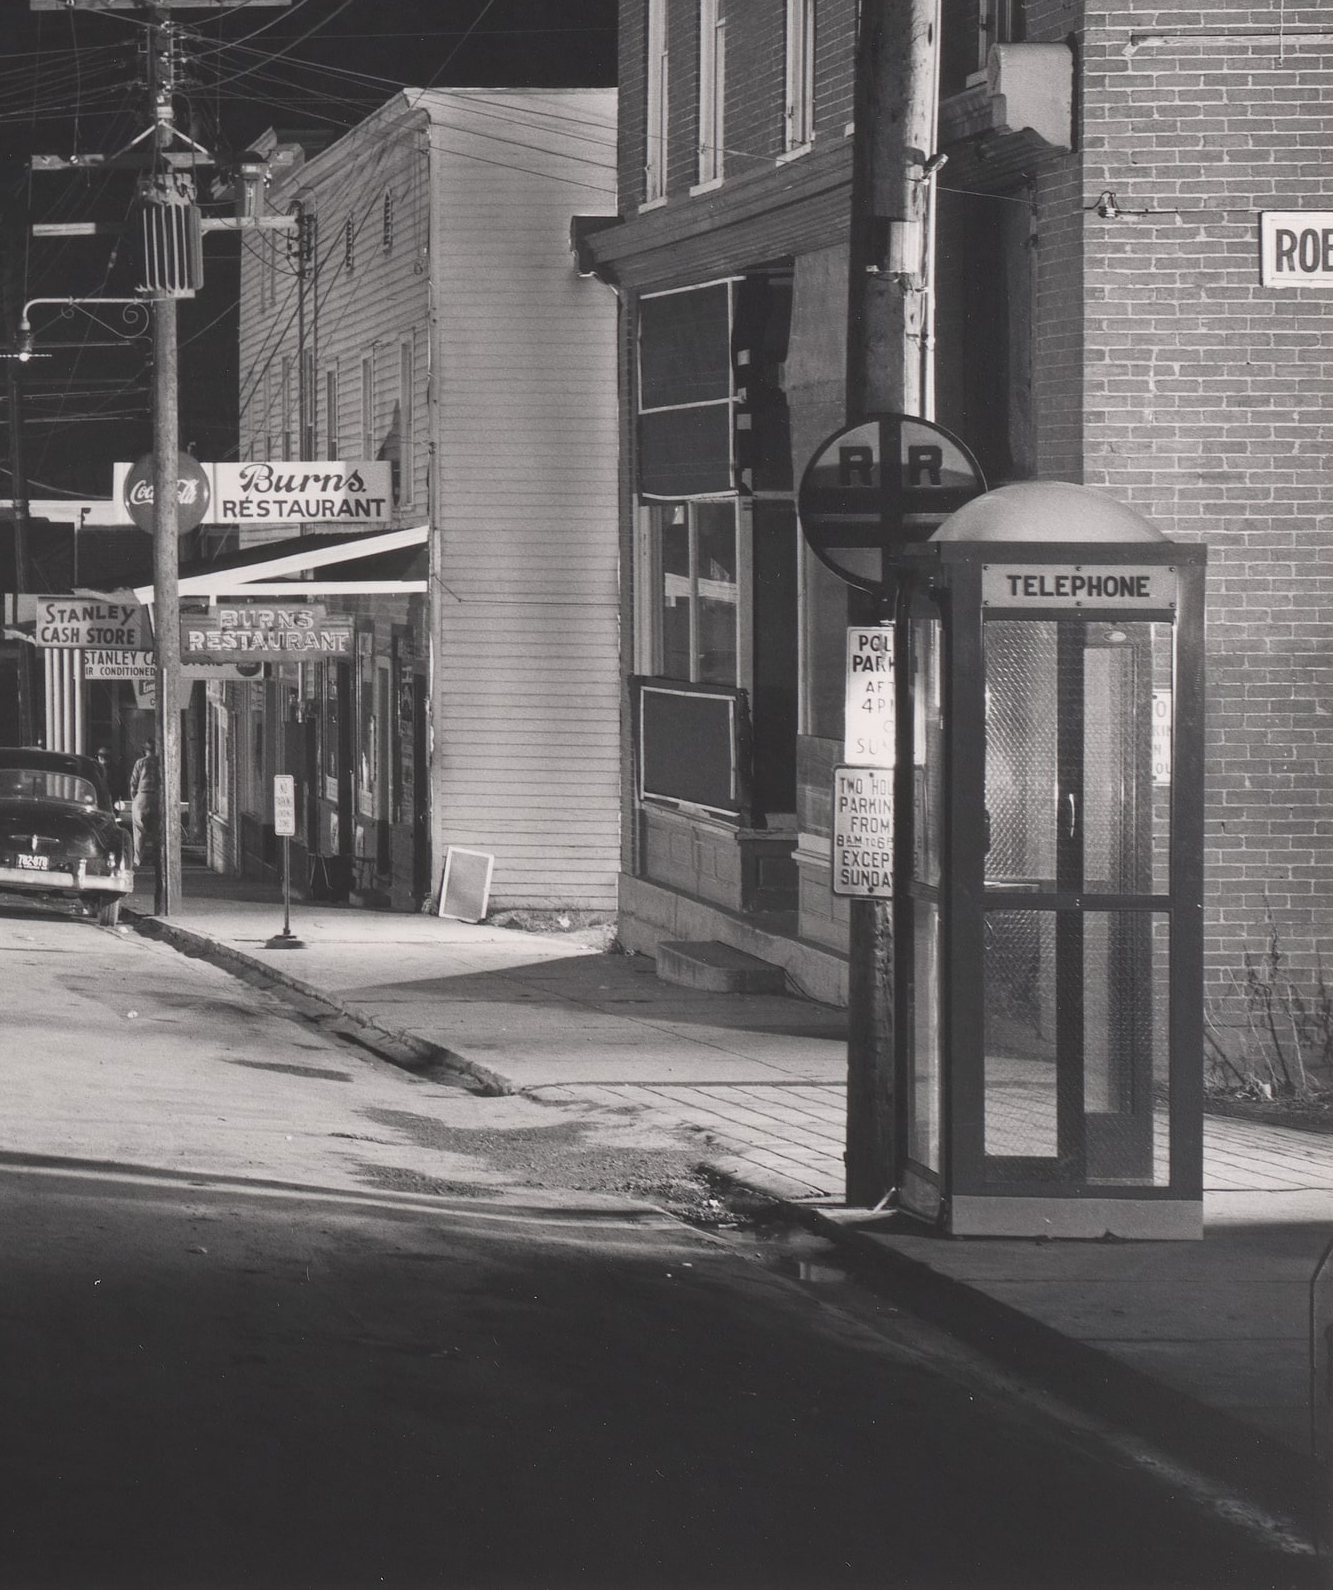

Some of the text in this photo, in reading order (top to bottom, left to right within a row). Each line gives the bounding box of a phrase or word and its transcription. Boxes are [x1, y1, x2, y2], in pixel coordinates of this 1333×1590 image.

[839, 445, 943, 486] R R
[222, 498, 386, 518] RESTAURANT
[1006, 575, 1151, 598] TELEPHONE
[45, 603, 135, 626] STANLEY
[219, 609, 315, 630] BURNS
[41, 627, 135, 645] CASH STORE
[188, 630, 350, 652] RESTAURANT
[100, 666, 156, 677] CONDITIONED
[839, 777, 895, 796] TWO HOU
[839, 796, 894, 814] PARKIN
[850, 816, 892, 834] FROM
[841, 850, 893, 870] EXCEP
